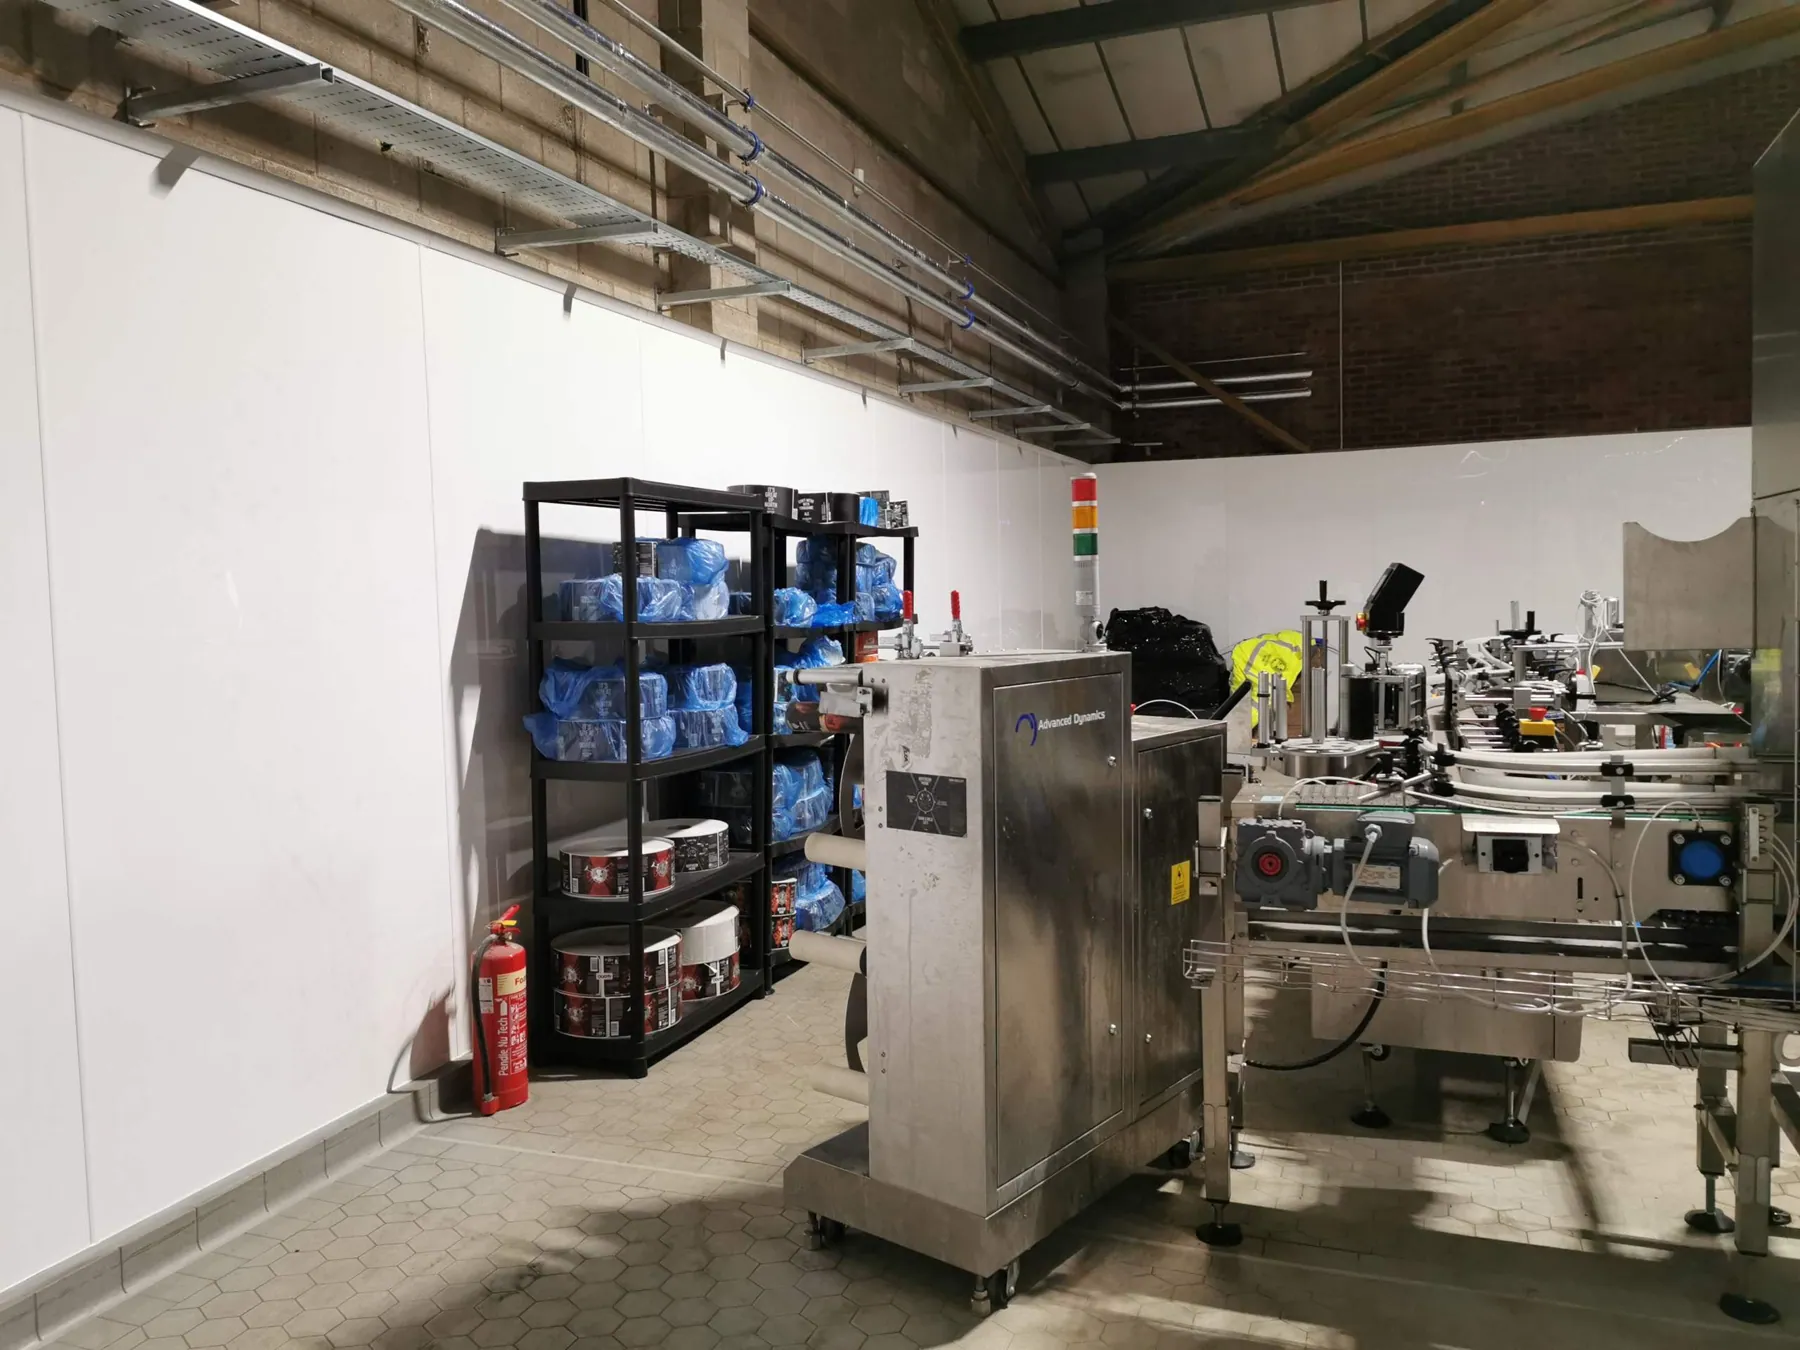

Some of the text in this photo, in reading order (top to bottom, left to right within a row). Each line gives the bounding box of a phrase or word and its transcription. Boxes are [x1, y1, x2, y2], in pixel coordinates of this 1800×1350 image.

[1038, 710, 1106, 730] Advanced Dynamics
[497, 1017, 509, 1076] Pendle Nu Tech
